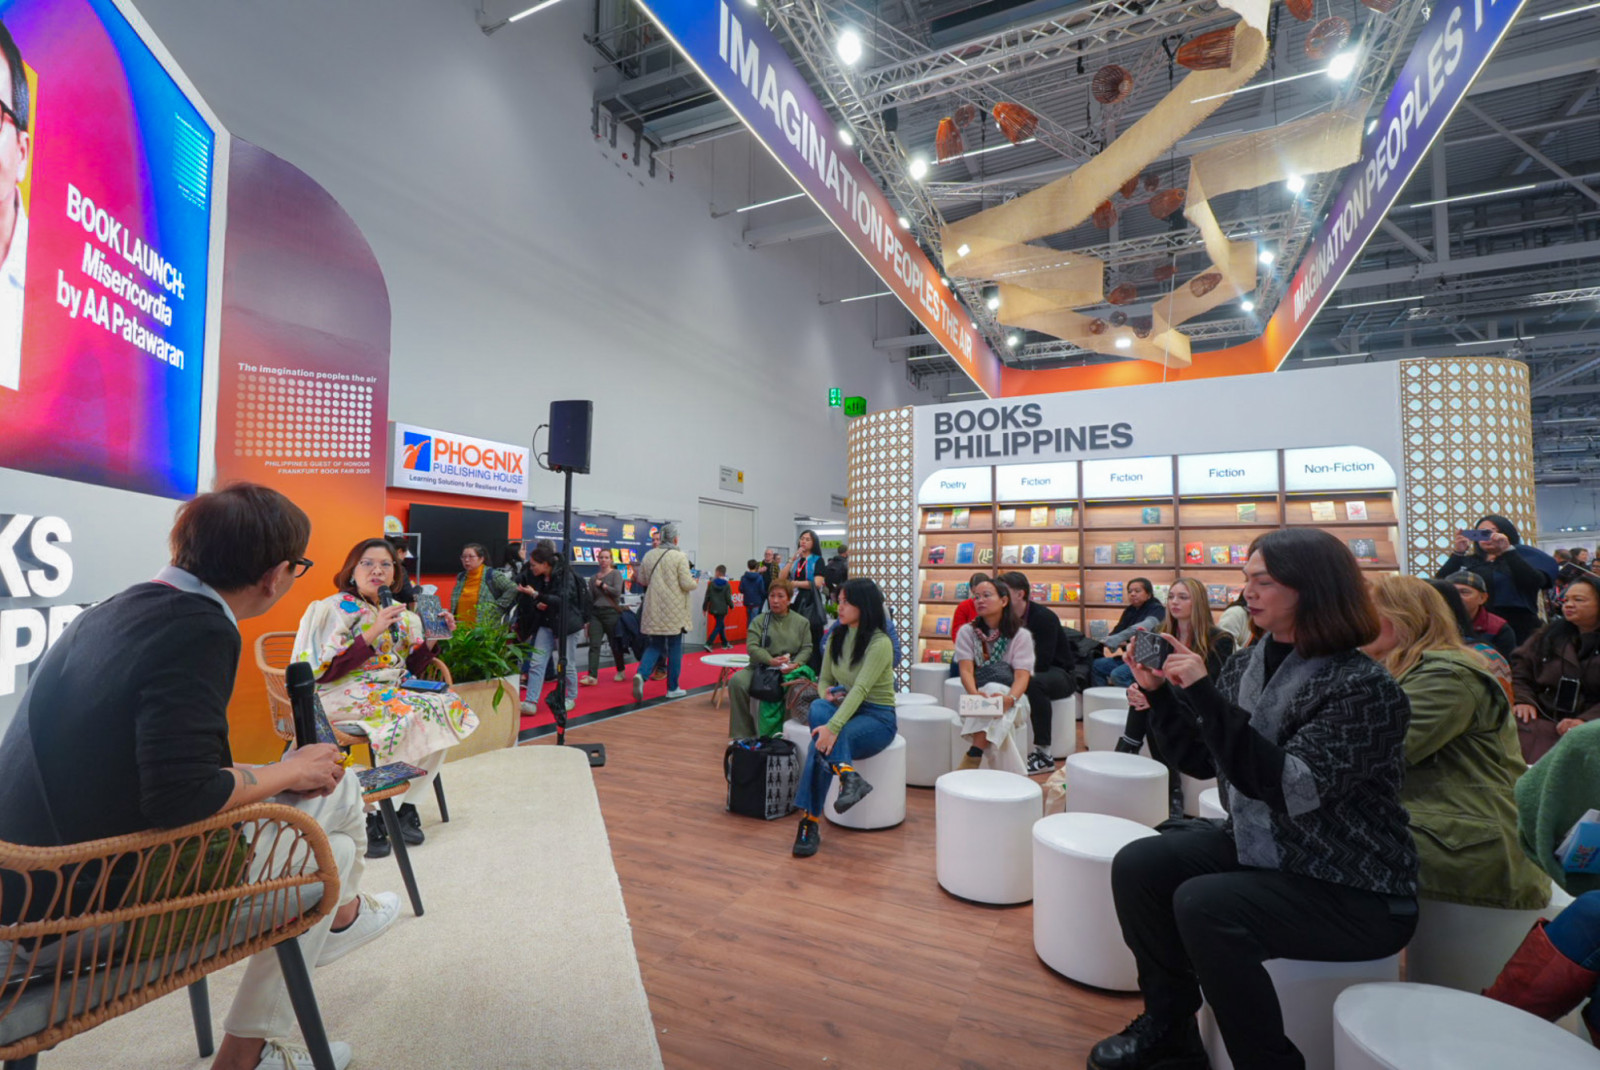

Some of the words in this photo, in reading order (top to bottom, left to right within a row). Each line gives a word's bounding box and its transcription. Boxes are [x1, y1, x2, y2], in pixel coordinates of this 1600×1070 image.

[1294, 177, 1364, 323] IMAGINATION
[1366, 6, 1463, 209] PEOPLES
[719, 0, 883, 253] IMAGINATION
[885, 225, 940, 322] PEOPLES
[941, 299, 959, 345] THE
[959, 327, 972, 363] AIR
[66, 182, 122, 255] BOOK
[123, 227, 185, 300] LAUNCH:
[82, 241, 172, 327] Misericordia
[56, 268, 82, 318] by
[82, 287, 111, 330] AA
[112, 302, 184, 370] Patawaran
[238, 362, 257, 372] The
[259, 365, 315, 377] imagination
[316, 371, 350, 381] peoples
[351, 374, 365, 383] the
[934, 403, 1043, 435] BOOKS
[934, 422, 1134, 460] PHILIPPINES
[434, 438, 523, 474] PHOENIX
[1304, 461, 1375, 474] Non-Fiction
[409, 474, 437, 485] Learning
[438, 478, 465, 487] Solutions
[475, 482, 498, 491] Resilient
[498, 484, 518, 493] Futures
[433, 462, 492, 481] PUBLISHING
[493, 473, 523, 485] HOUSE
[940, 480, 967, 490] Poetry
[1021, 477, 1051, 486] Fiction
[1110, 472, 1143, 482] Fiction
[1209, 468, 1246, 478] Fiction
